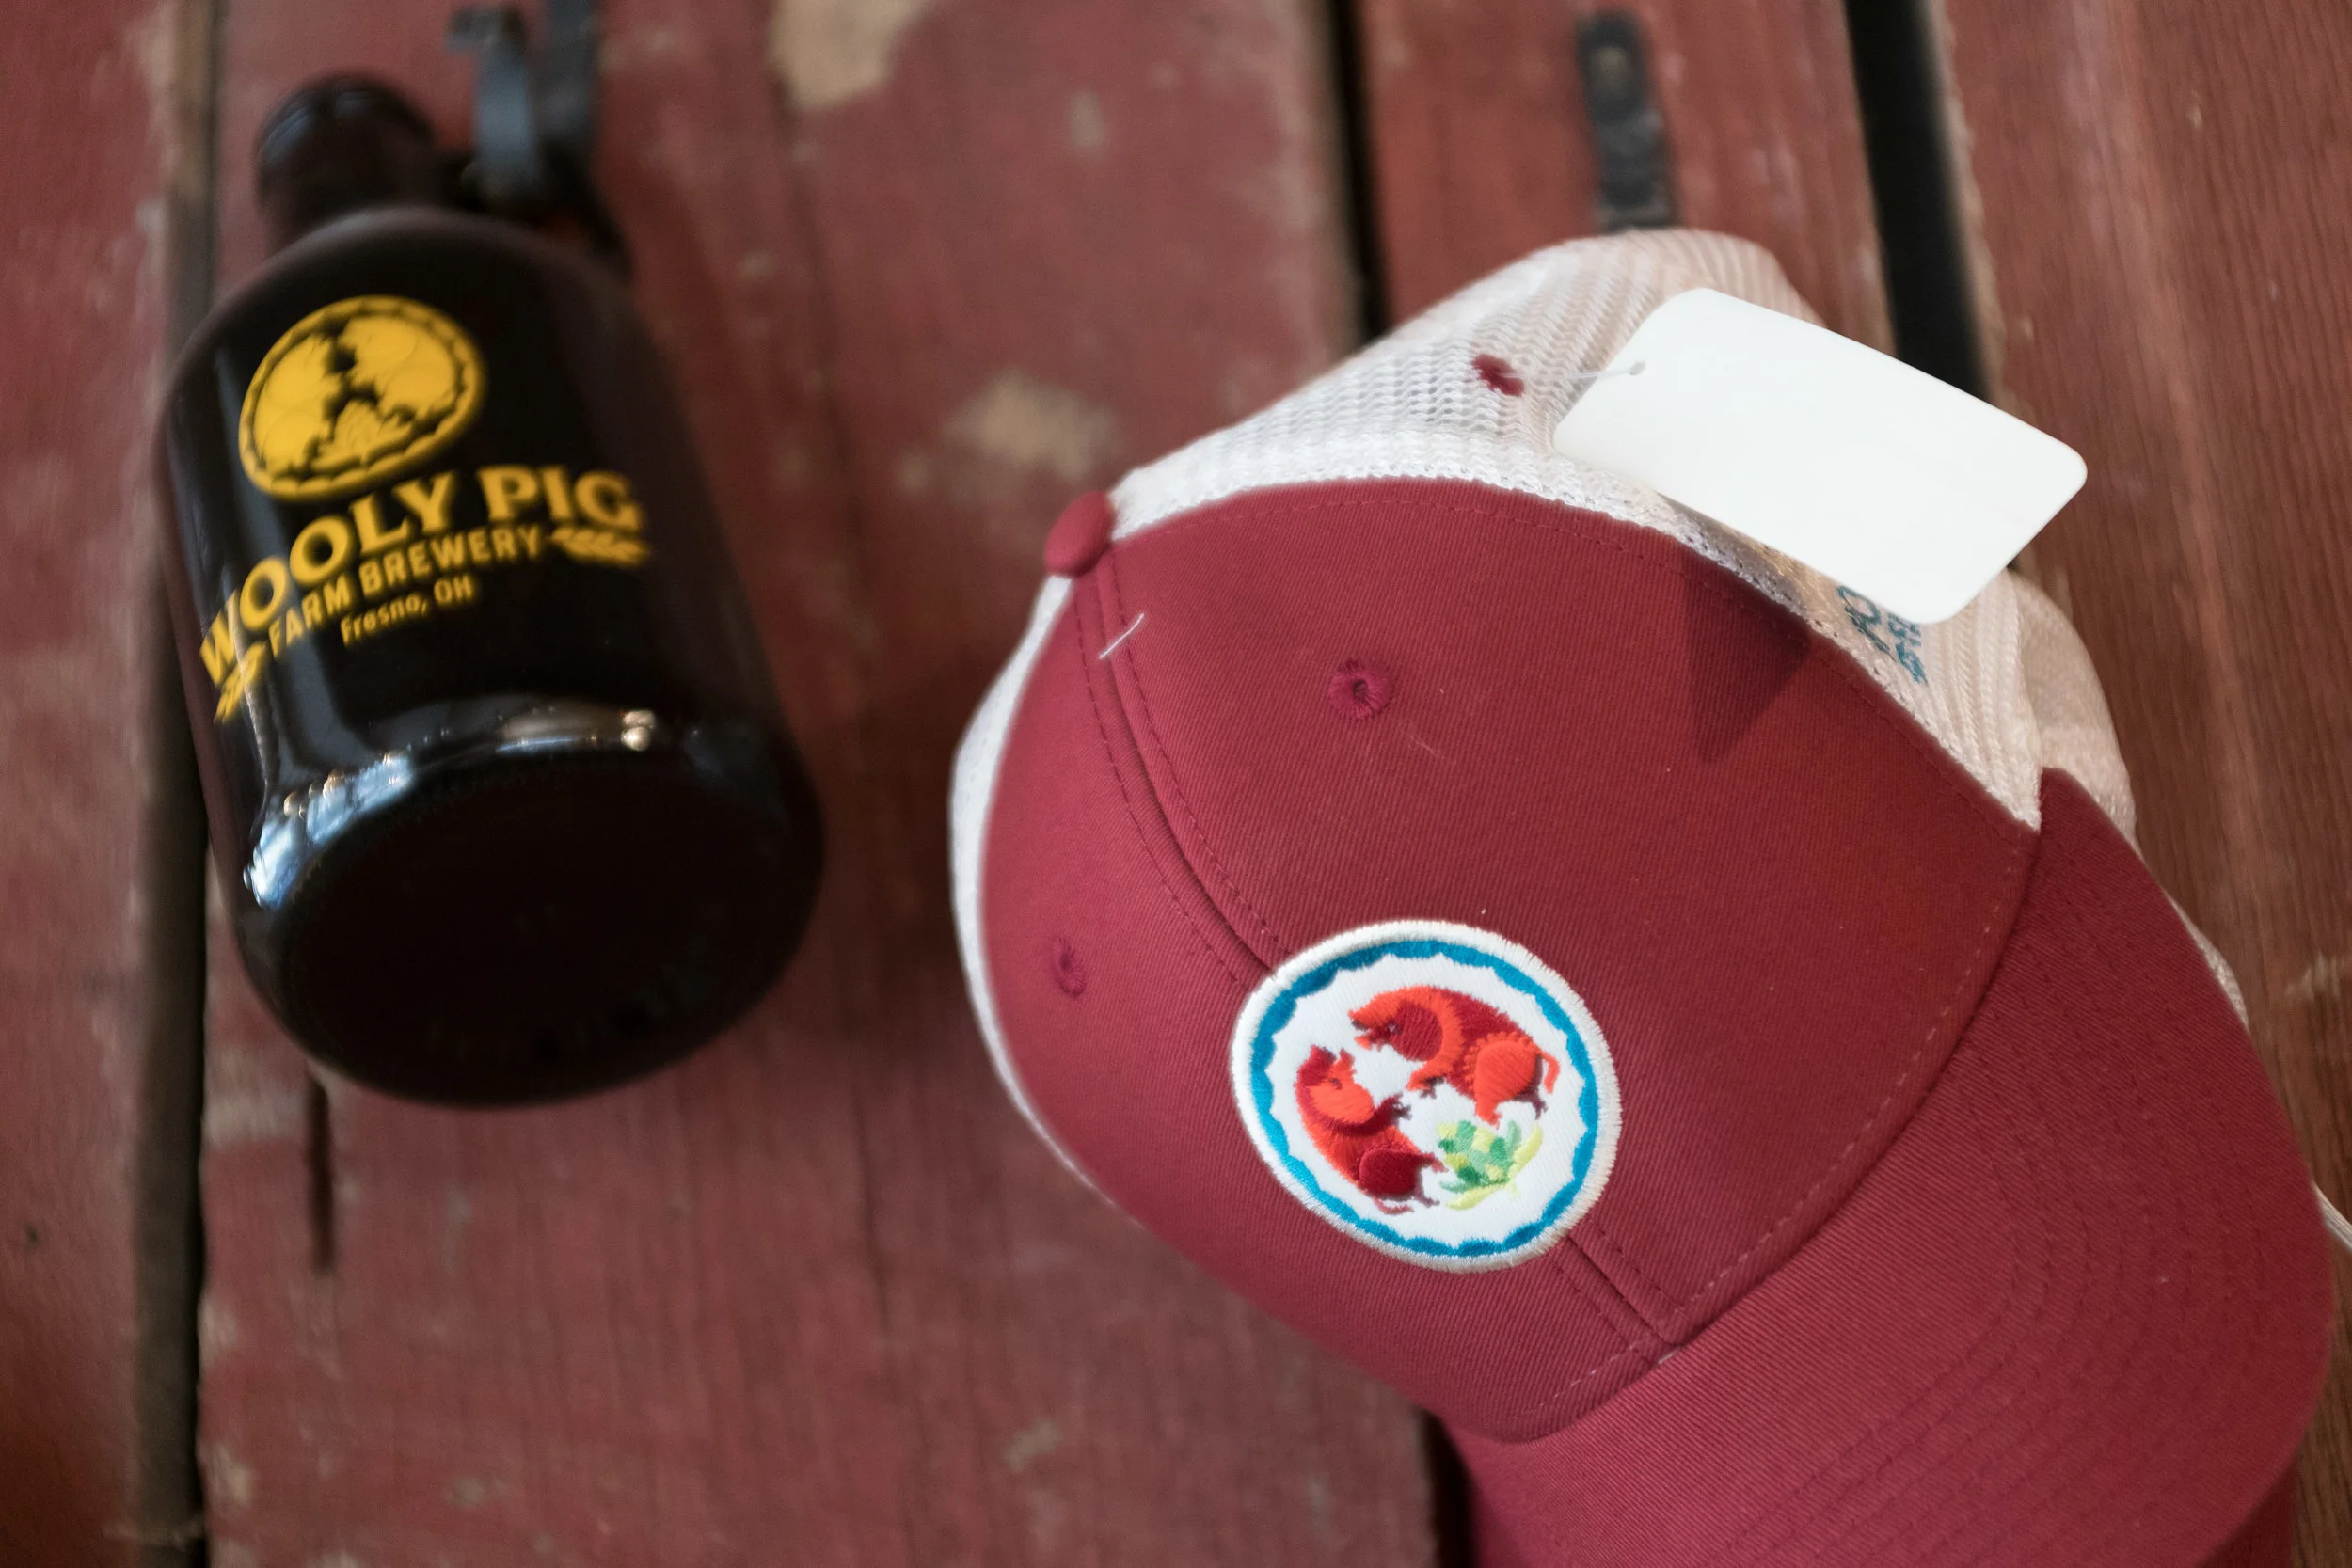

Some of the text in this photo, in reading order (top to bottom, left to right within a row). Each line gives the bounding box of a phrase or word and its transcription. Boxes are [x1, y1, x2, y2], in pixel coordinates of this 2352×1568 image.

[200, 466, 642, 688] WOOLY PIG
[268, 525, 543, 657] FARM BREWERY
[340, 575, 475, 646] Fresno, OH
